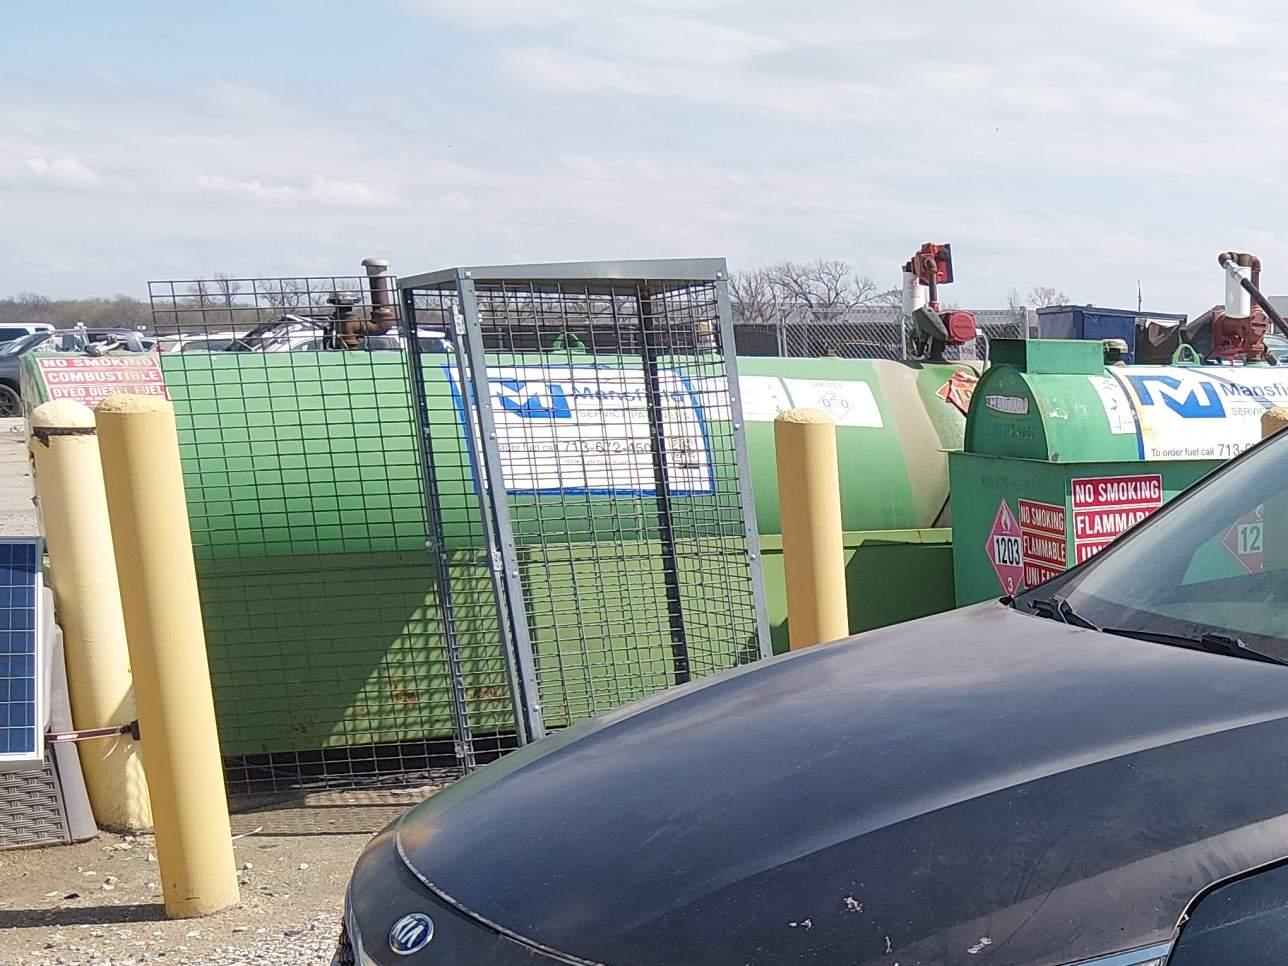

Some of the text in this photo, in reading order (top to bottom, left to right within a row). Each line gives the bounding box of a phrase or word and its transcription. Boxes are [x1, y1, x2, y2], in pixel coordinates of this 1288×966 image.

[43, 359, 68, 367] NO
[47, 371, 160, 383] COMBUSTIBLE
[53, 387, 87, 397] DYED
[135, 385, 165, 394] FUEL
[1151, 448, 1161, 457] To
[1162, 448, 1183, 457] order
[1185, 447, 1199, 457] fuel
[1200, 447, 1215, 456] call
[1075, 480, 1160, 504] NO SMOKING
[1020, 505, 1065, 531] NO SMOKING
[995, 536, 1021, 566] 1203
[1023, 535, 1066, 562] FLAMMABLE
[1007, 576, 1014, 591] 3
